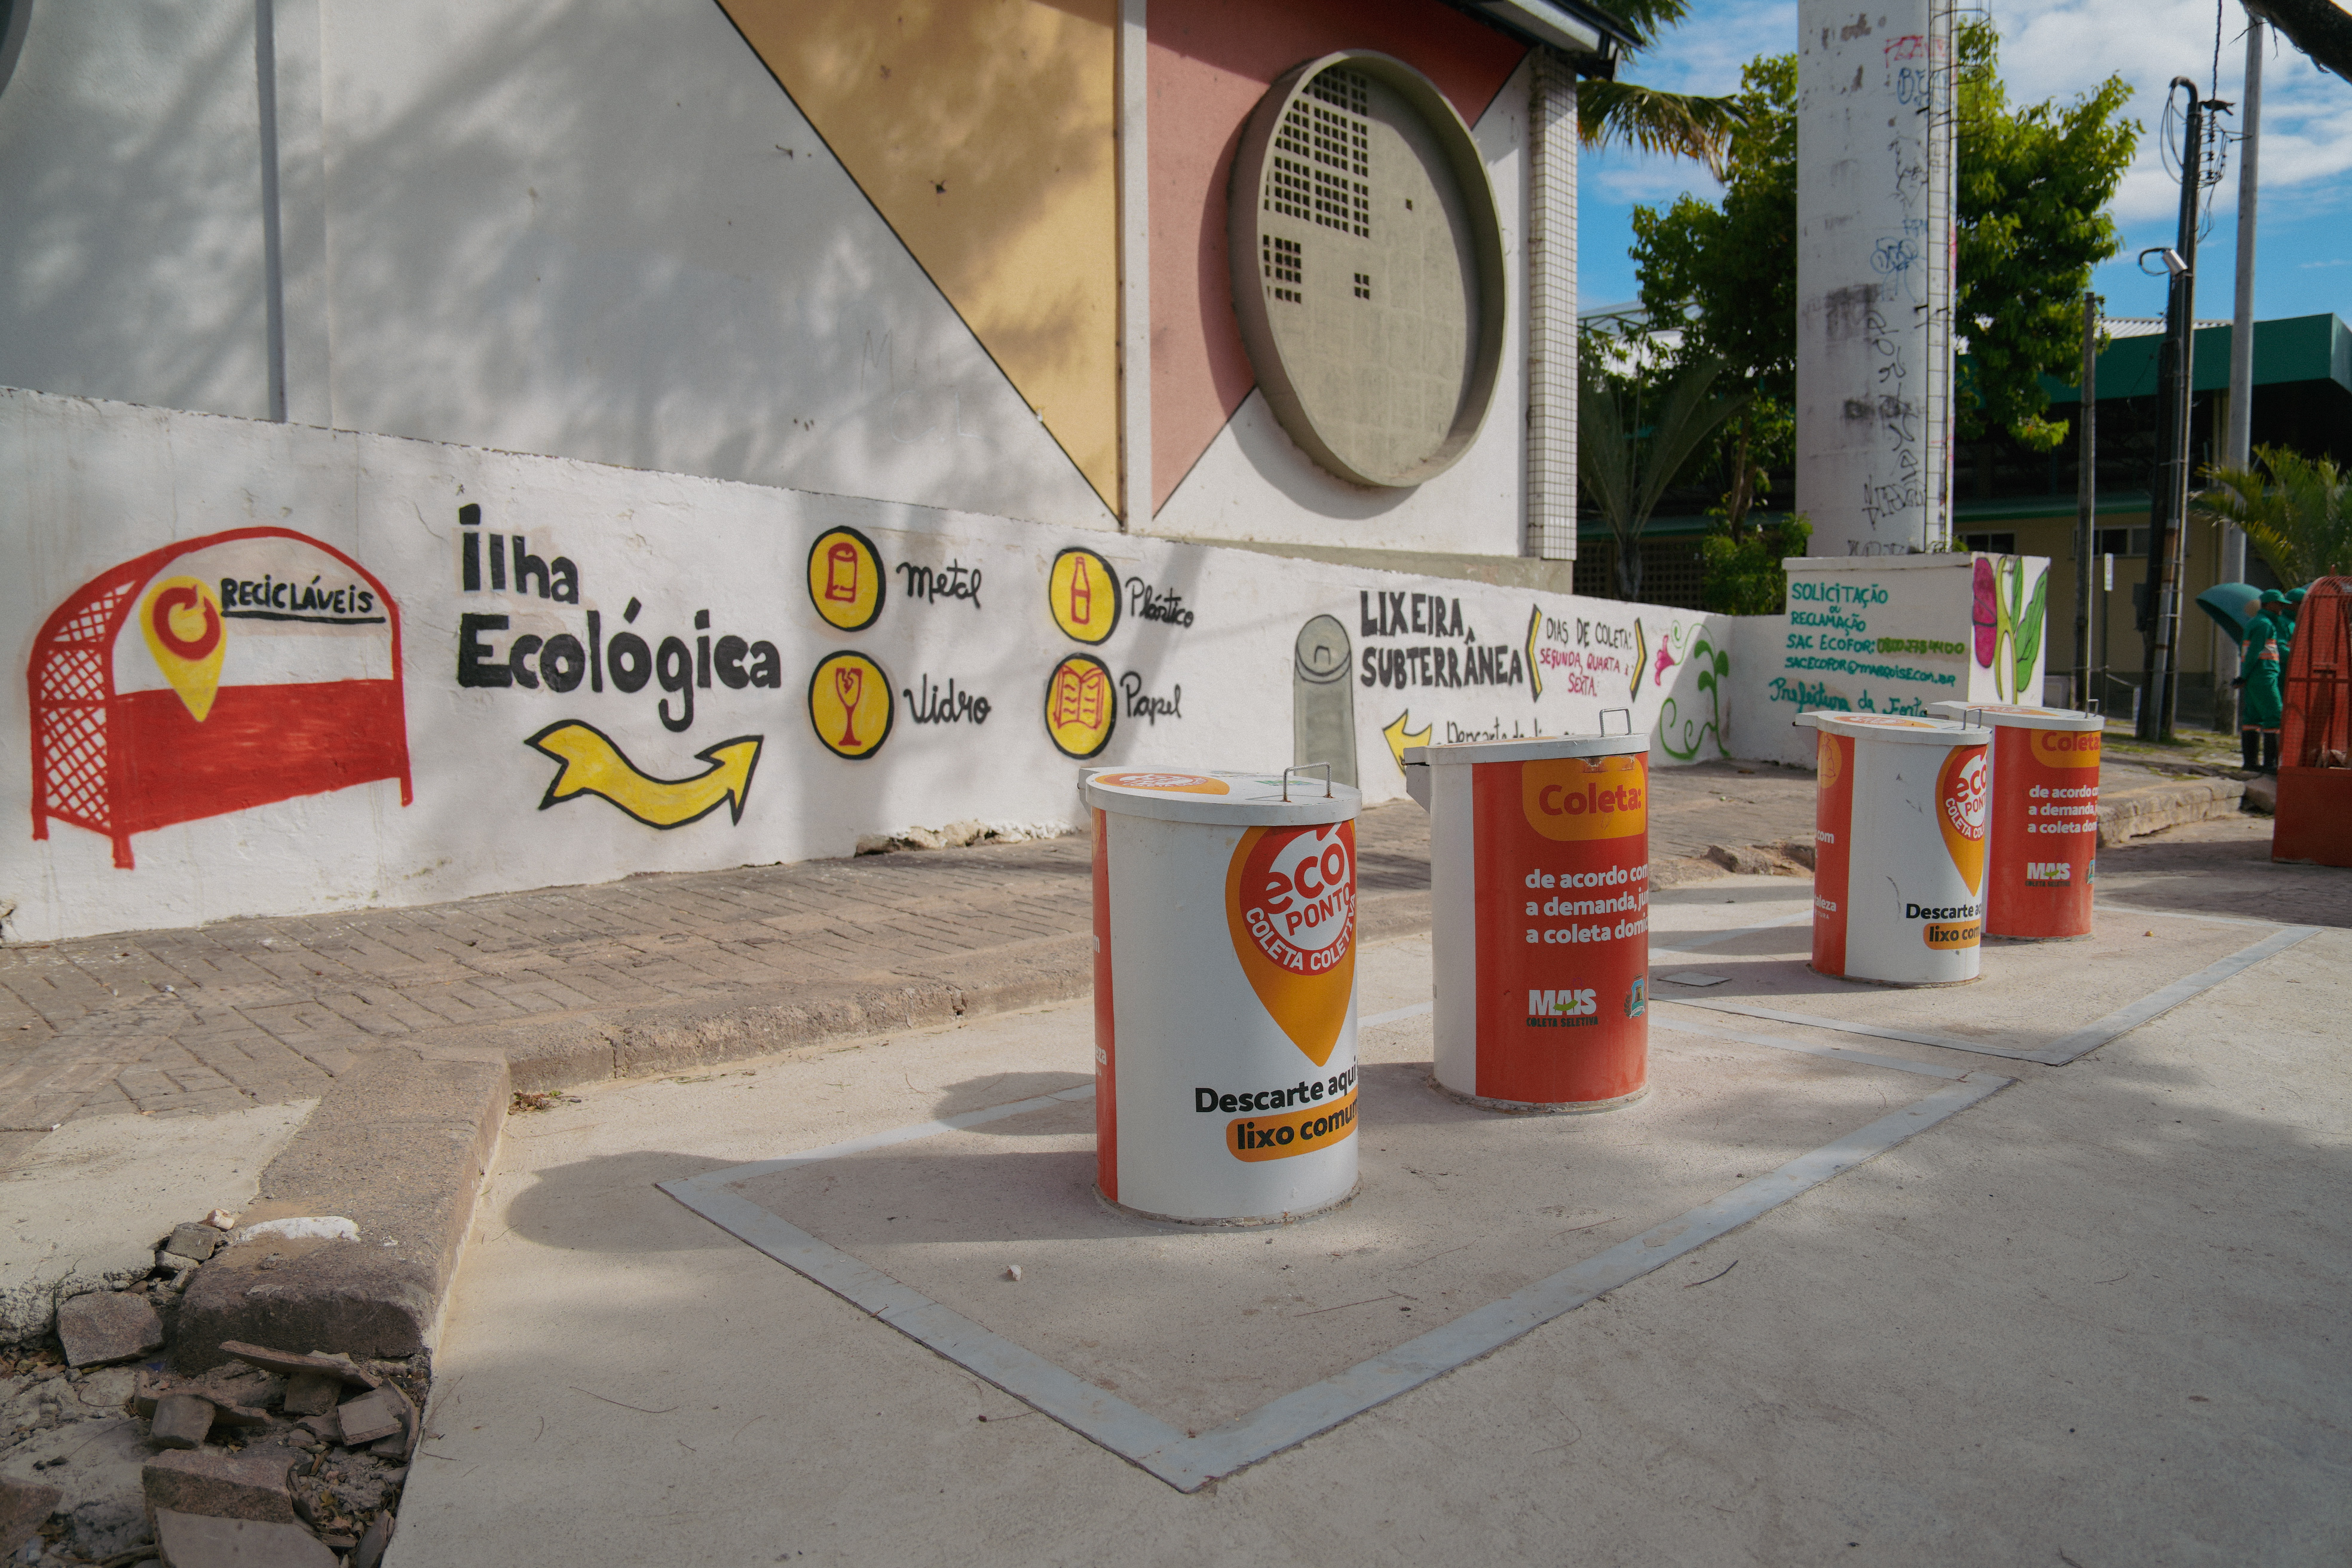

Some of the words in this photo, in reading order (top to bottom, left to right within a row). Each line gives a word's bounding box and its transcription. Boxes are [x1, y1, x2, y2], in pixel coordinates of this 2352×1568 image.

[1360, 590, 1465, 638] LIXEIRA
[1546, 617, 1569, 647] DIAS
[1576, 617, 1590, 648] DE
[1786, 633, 1814, 650] SAC
[458, 596, 782, 733] Ecológica
[1360, 625, 1523, 690] SUBTERRÂNEA
[1587, 653, 1620, 673] QUARTA
[902, 672, 991, 724] Vidro
[1120, 670, 1181, 725] Papel
[1539, 782, 1642, 816] Coleta:
[2029, 785, 2050, 798] de
[2051, 785, 2091, 798] acordo
[1945, 797, 1971, 838] COLETA
[2028, 806, 2037, 816] a
[2028, 823, 2036, 833] a
[2039, 820, 2081, 834] coleta
[1525, 869, 1555, 889] de
[1560, 865, 1628, 887] acordo
[2027, 862, 2071, 880] MAIS
[1285, 882, 1351, 936] PONTO
[1526, 901, 1538, 916] a
[1544, 890, 1637, 916] demanda,
[1906, 903, 1974, 919] Descarte
[1247, 907, 1303, 971] COLETA
[1310, 893, 1356, 971] COLETIVA
[1526, 929, 1538, 944] a
[1544, 923, 1611, 944] coleta
[1929, 925, 1959, 942] lixo
[1529, 988, 1597, 1015] MAIS
[1526, 1017, 1558, 1027] COLETA
[1560, 1016, 1598, 1027] SELETIVA
[1195, 1080, 1324, 1113] Descarte
[1328, 1055, 1356, 1097] aqui
[1238, 1122, 1294, 1150] lixo
